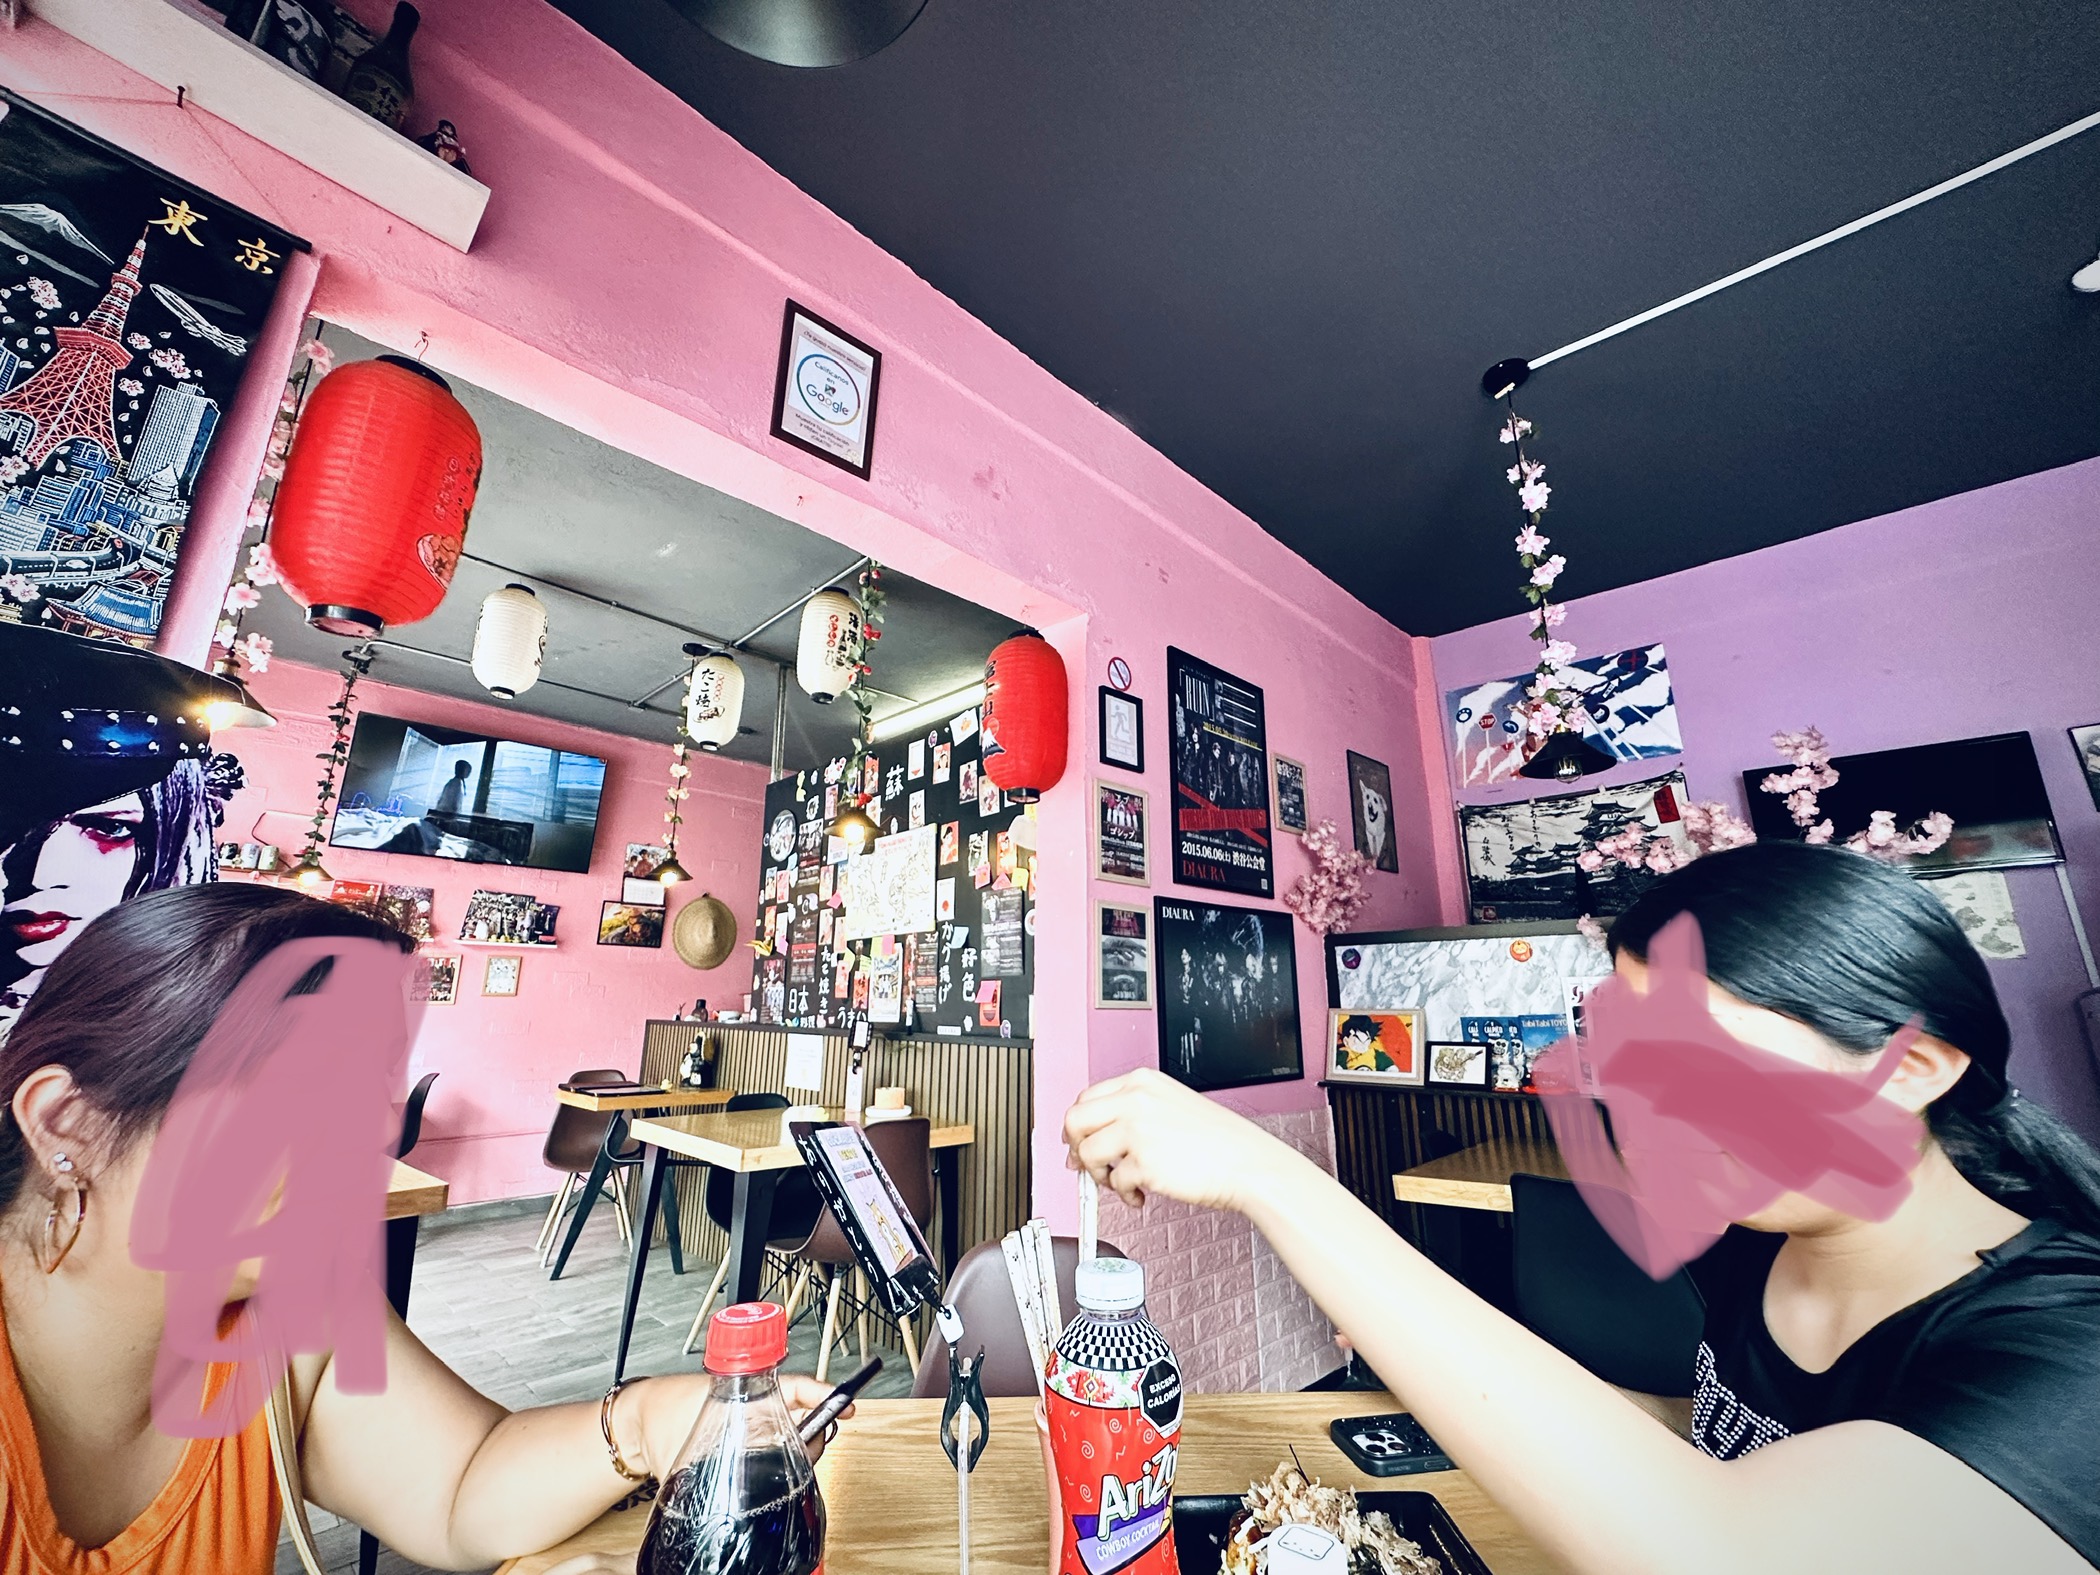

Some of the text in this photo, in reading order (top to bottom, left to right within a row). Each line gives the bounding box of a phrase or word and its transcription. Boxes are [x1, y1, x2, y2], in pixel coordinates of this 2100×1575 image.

[826, 377, 835, 385] en
[806, 383, 850, 416] Google
[1479, 716, 1496, 727] STOP
[1182, 860, 1226, 882] DIAURA
[1161, 906, 1195, 922] DIAURA
[788, 984, 809, 1015] 日本
[837, 1006, 867, 1029] うまい
[1521, 1019, 1535, 1028] Tabi
[1535, 1019, 1550, 1027] Tabi
[1149, 1373, 1176, 1394] EXCESO
[1096, 1534, 1131, 1561] COWBOY
